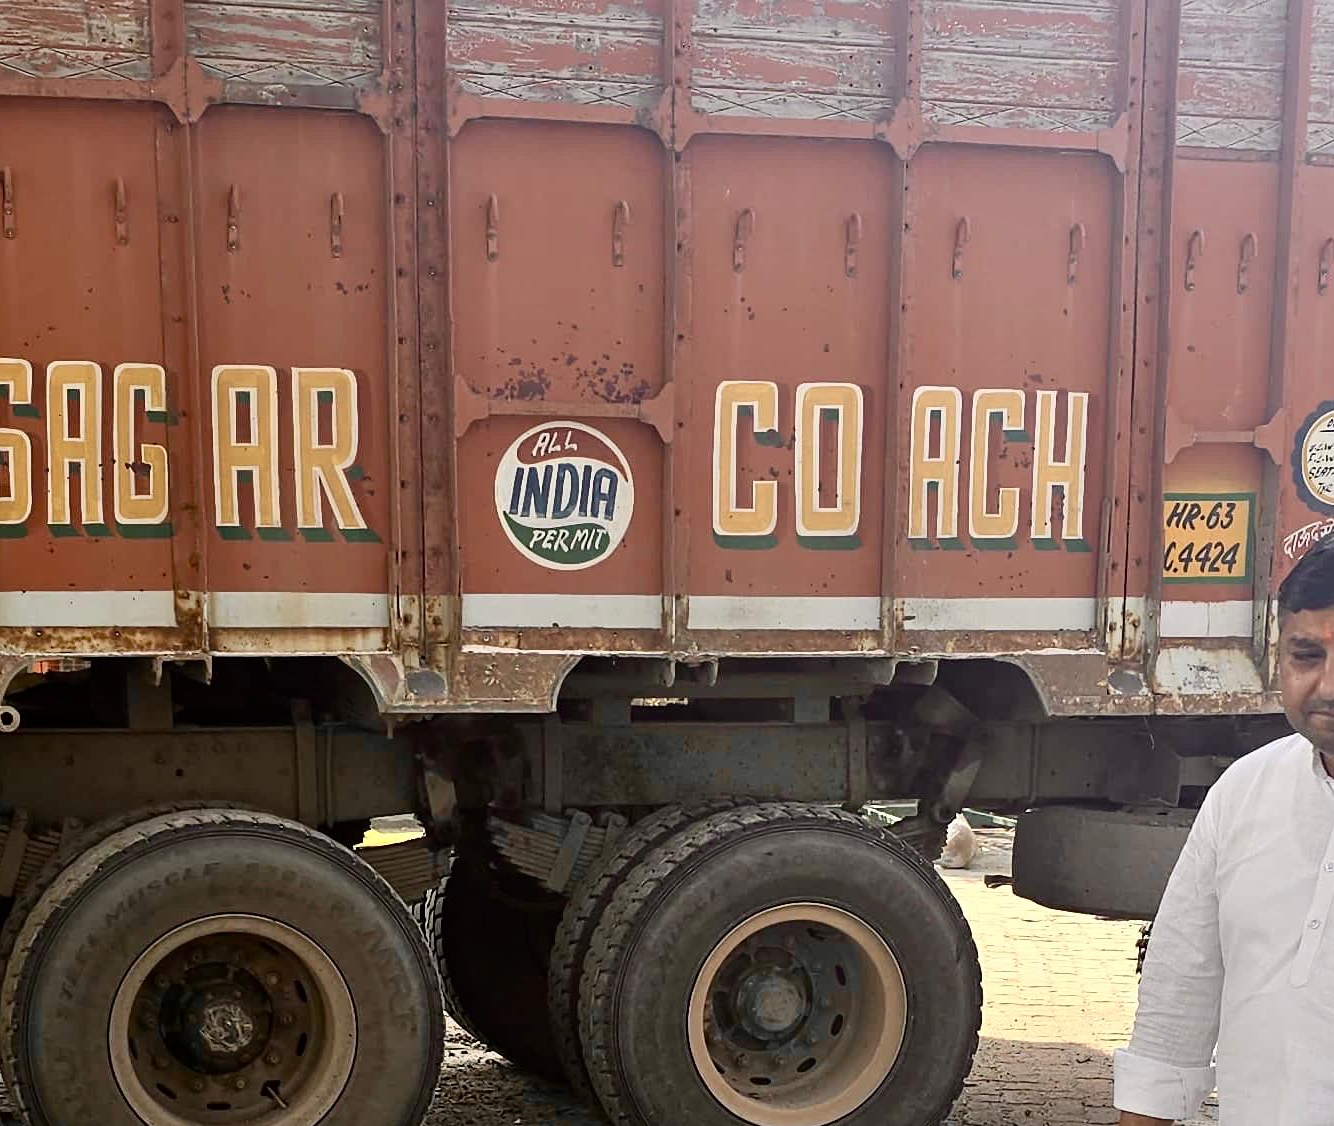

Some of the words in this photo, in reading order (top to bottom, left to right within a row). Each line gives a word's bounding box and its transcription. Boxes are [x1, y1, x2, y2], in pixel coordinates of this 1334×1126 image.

[532, 430, 578, 457] ALL
[509, 462, 619, 521] INDIA
[529, 528, 607, 552] PERMIT
